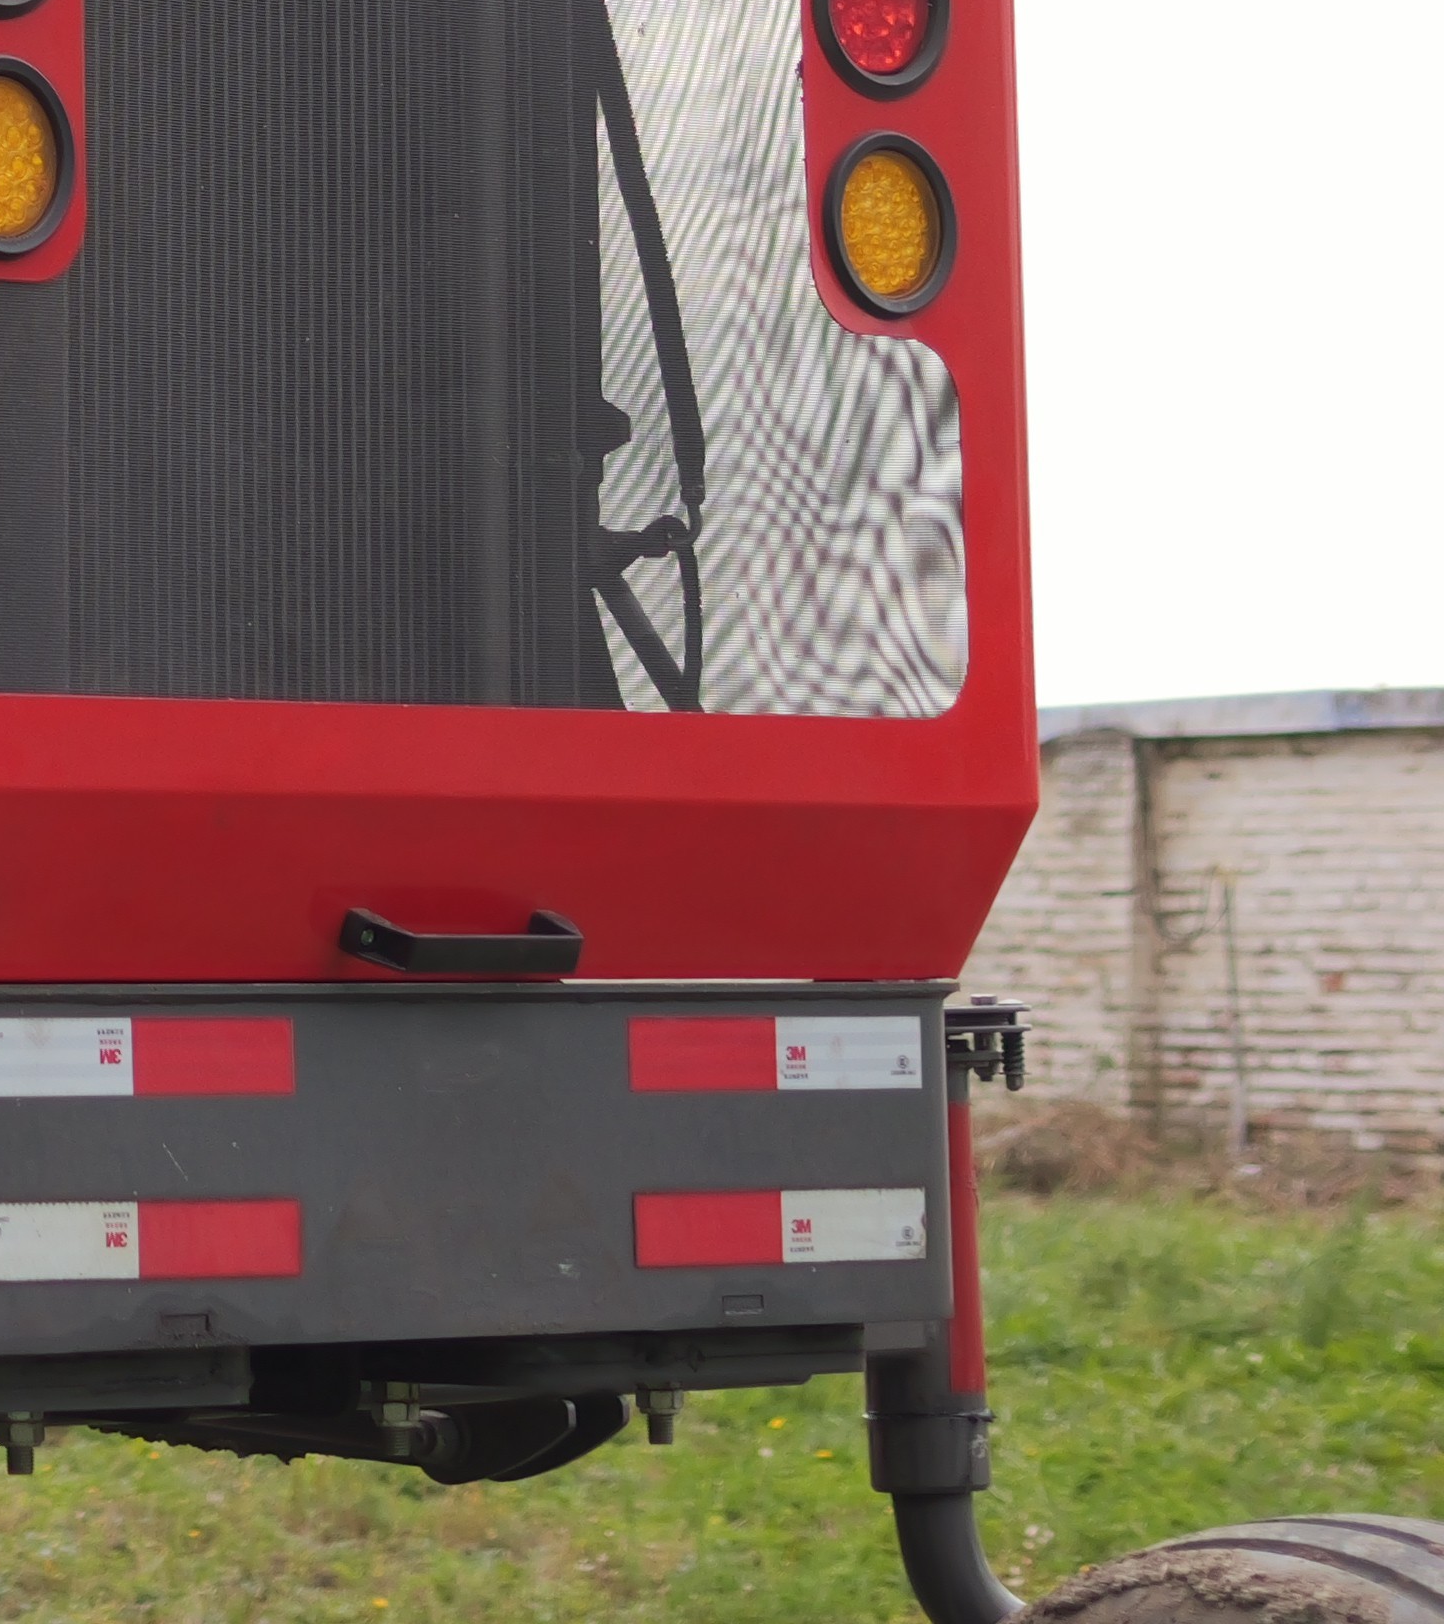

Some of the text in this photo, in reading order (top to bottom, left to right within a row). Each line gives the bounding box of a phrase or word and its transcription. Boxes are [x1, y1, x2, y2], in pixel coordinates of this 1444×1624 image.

[99, 1048, 122, 1065] 3M
[785, 1046, 806, 1061] 3M
[791, 1219, 812, 1234] 3M
[105, 1231, 128, 1248] 3M
